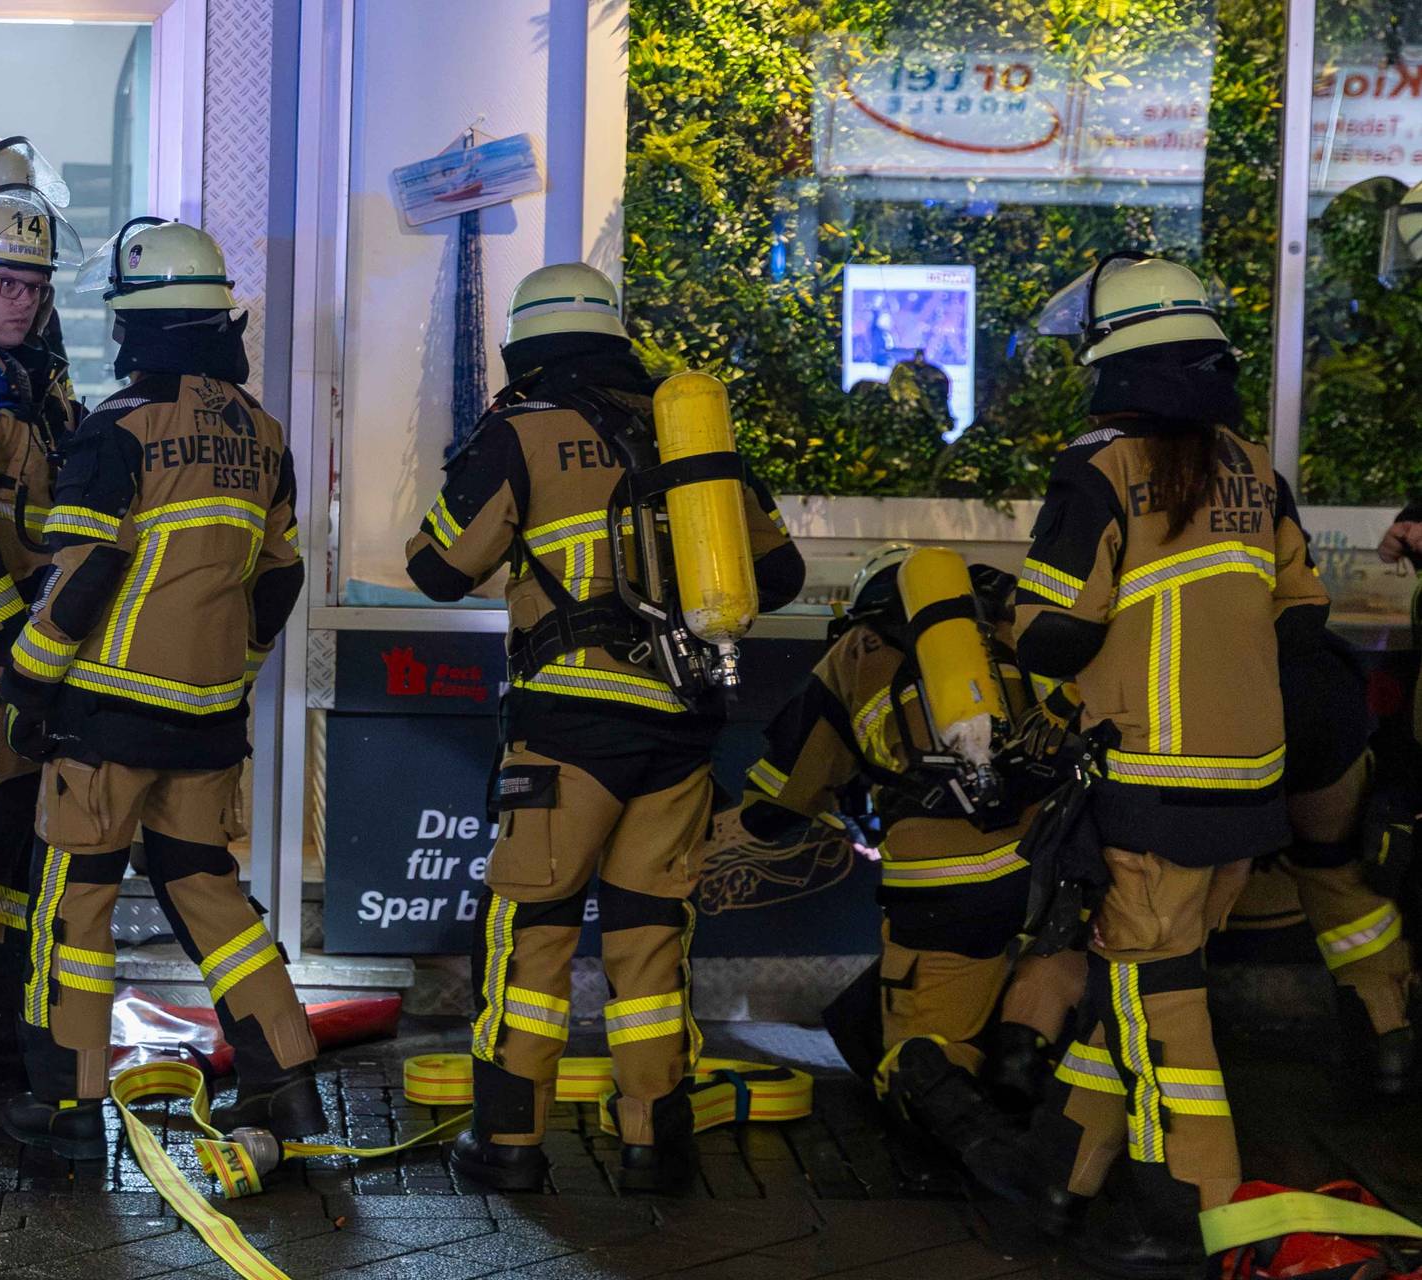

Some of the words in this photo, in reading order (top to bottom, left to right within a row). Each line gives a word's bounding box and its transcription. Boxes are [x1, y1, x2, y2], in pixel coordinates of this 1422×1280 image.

[12, 211, 42, 238] 14
[213, 466, 260, 492] ESSEN
[417, 809, 480, 839] Die
[406, 849, 460, 880] für
[358, 891, 448, 928] Spar
